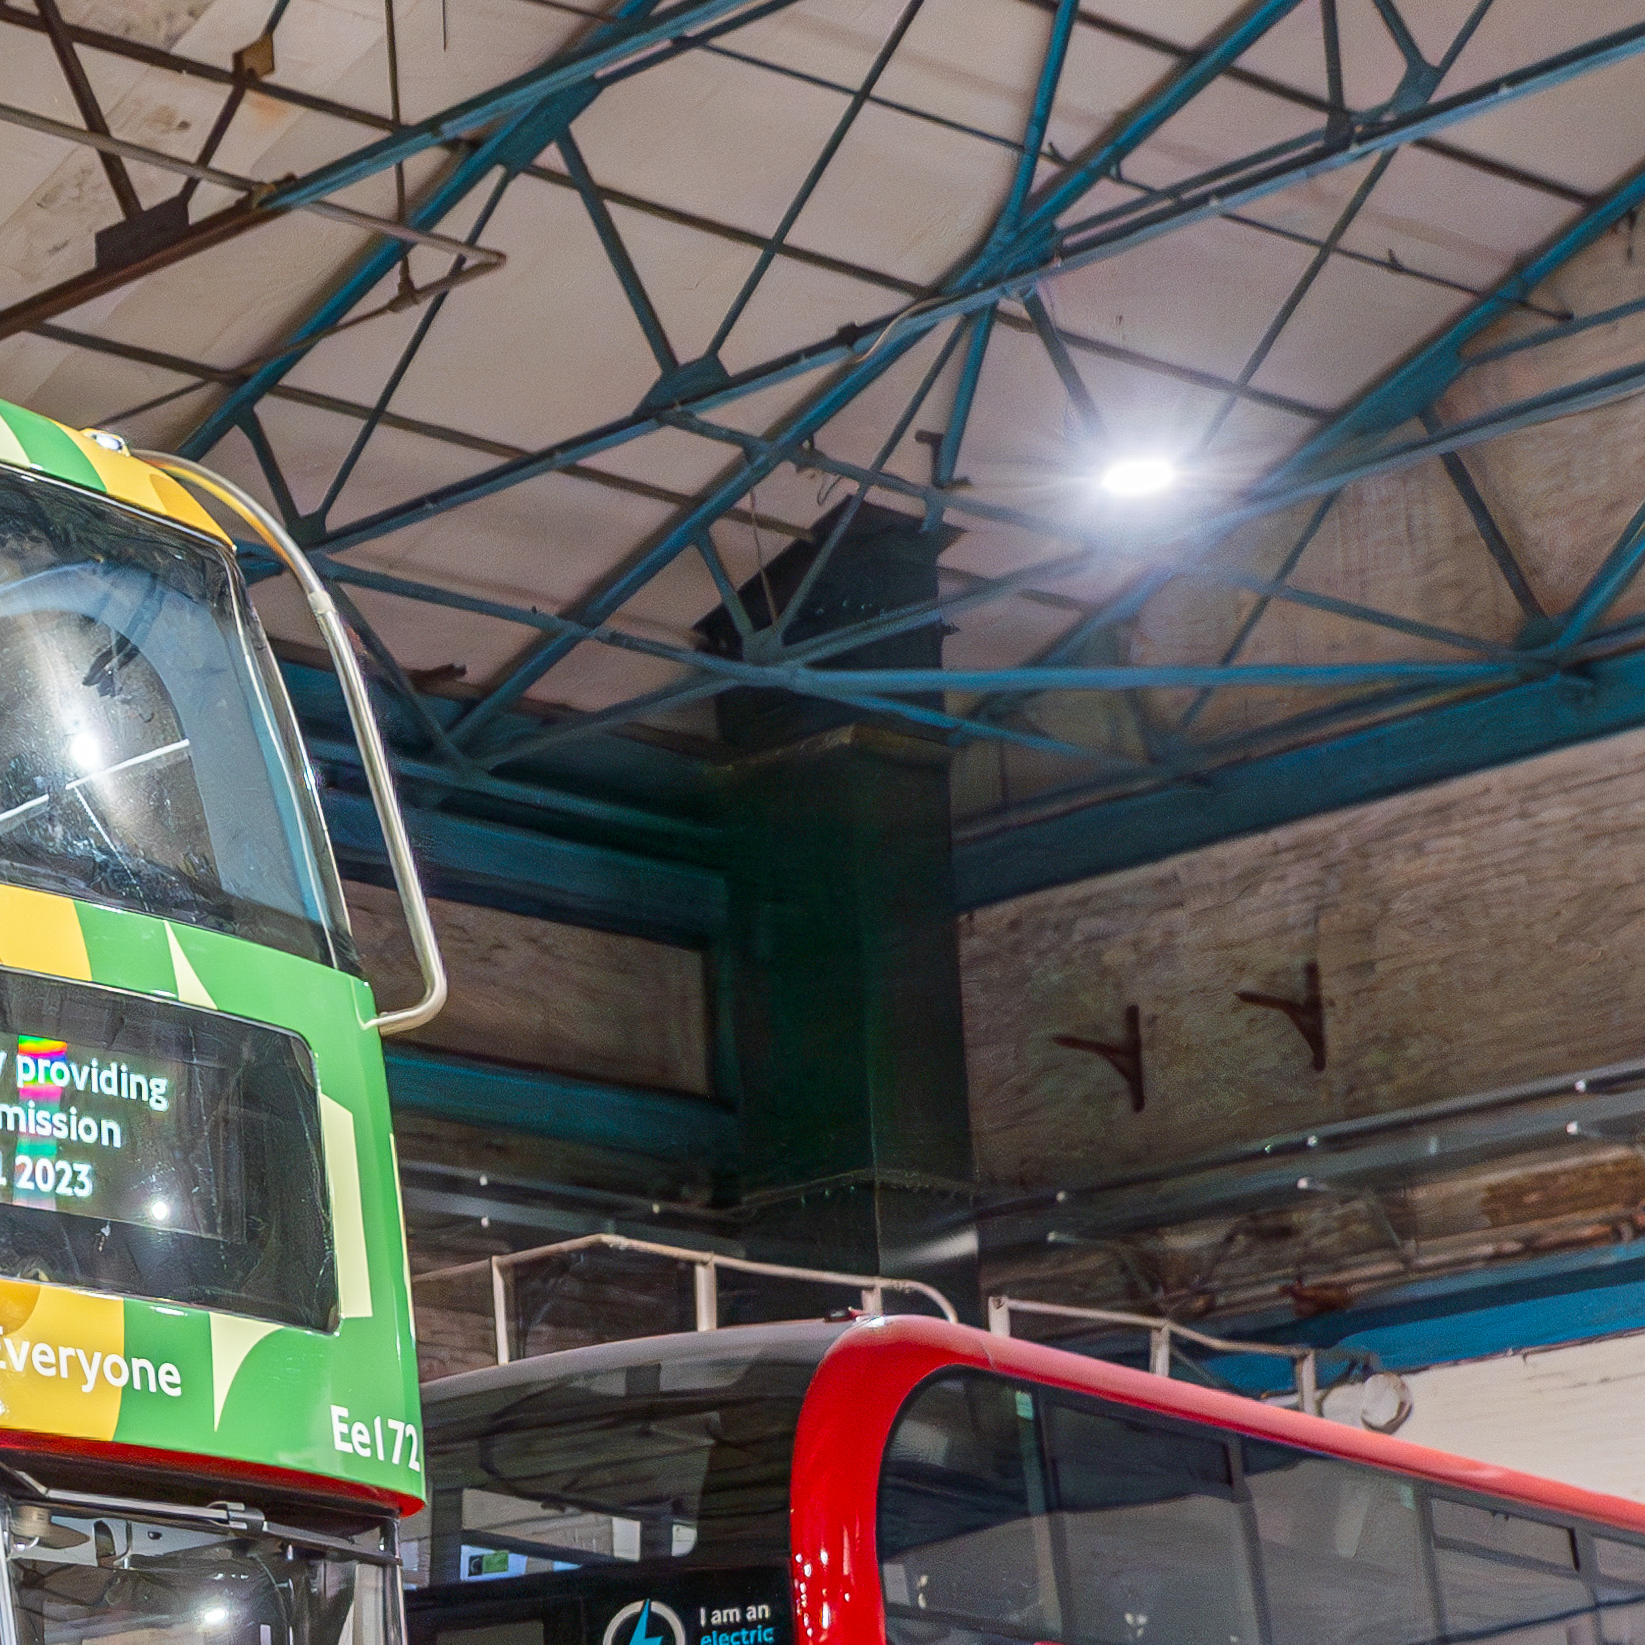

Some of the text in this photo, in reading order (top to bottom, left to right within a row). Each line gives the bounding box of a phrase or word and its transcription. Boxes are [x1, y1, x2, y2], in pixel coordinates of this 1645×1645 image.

[16, 1048, 170, 1113] providing
[14, 1156, 94, 1199] 2023
[331, 1405, 424, 1471] Ee172
[700, 1604, 770, 1627] I am an
